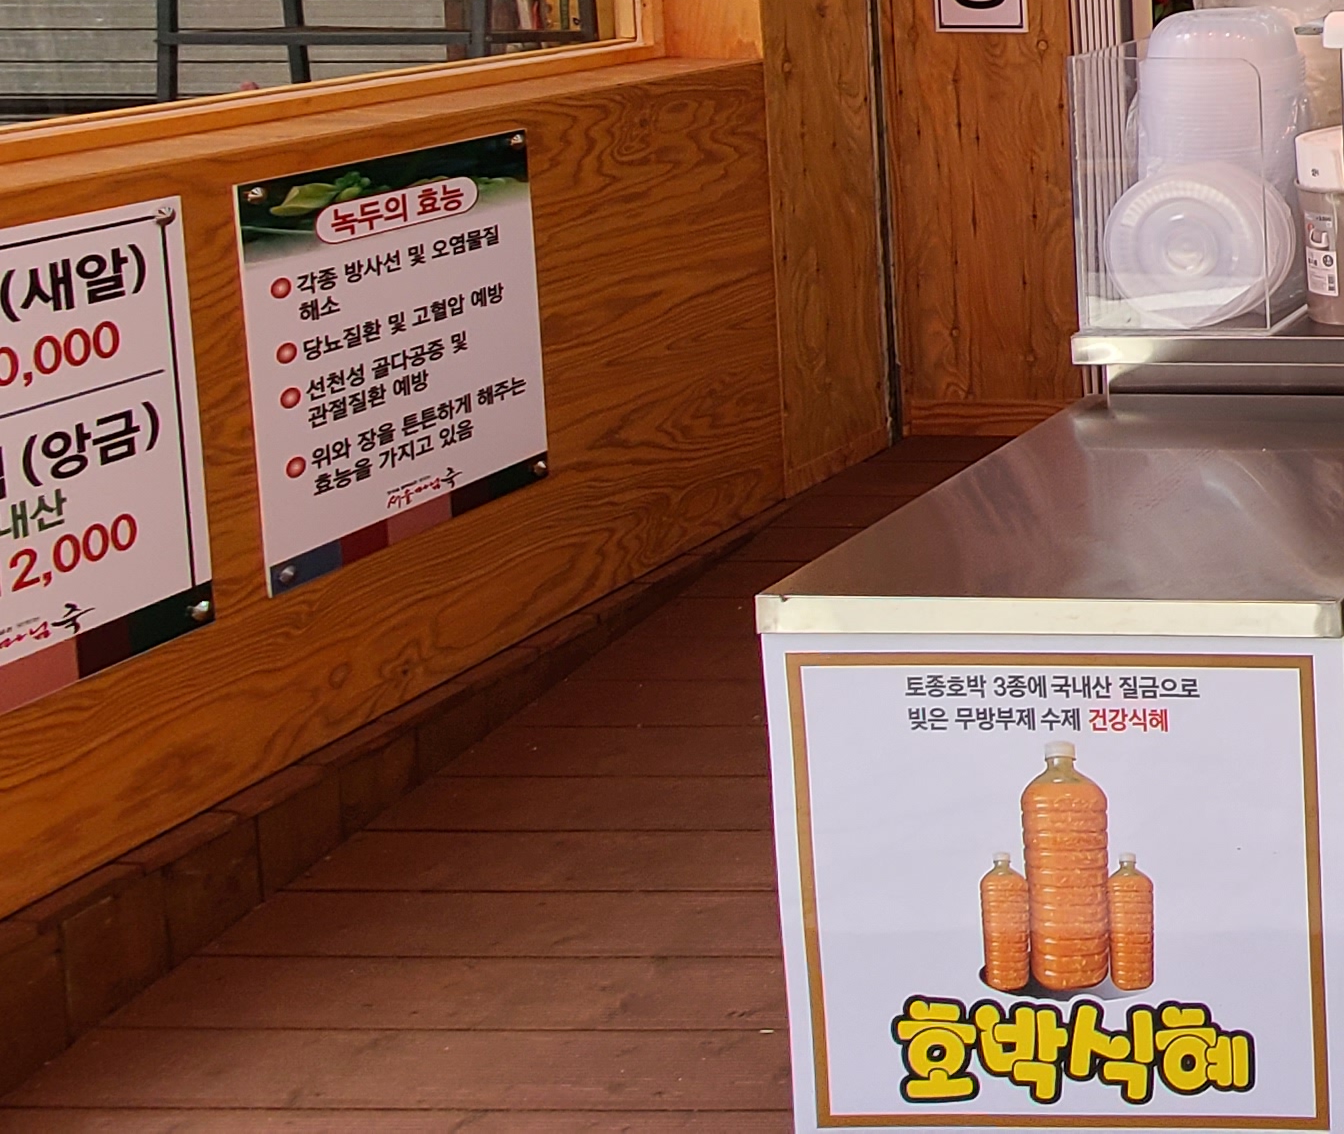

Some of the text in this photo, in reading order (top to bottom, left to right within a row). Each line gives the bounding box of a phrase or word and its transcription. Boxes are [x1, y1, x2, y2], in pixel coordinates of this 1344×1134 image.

[331, 184, 464, 236] 녹두의 효능
[297, 224, 500, 295] 각종 방사선 및 오염물질
[299, 295, 341, 321] 해소
[303, 282, 505, 361] 당뇨질환 및 고혈압 예방
[306, 330, 468, 401] 선천성 골다공증 및
[308, 369, 429, 430] 관절질환 예방
[311, 376, 527, 470] 위와 장을 튼튼하게 해주는
[313, 457, 373, 497] 효능을
[378, 435, 435, 470] 가지고
[438, 419, 475, 449] 있음
[0, 513, 137, 593] 2,000
[905, 675, 1200, 700] 토종호박 3종에 국내산 질금으로
[954, 707, 1037, 732] 무방부제
[1040, 708, 1081, 732] 수제
[891, 995, 1255, 1105] 호박식혜
